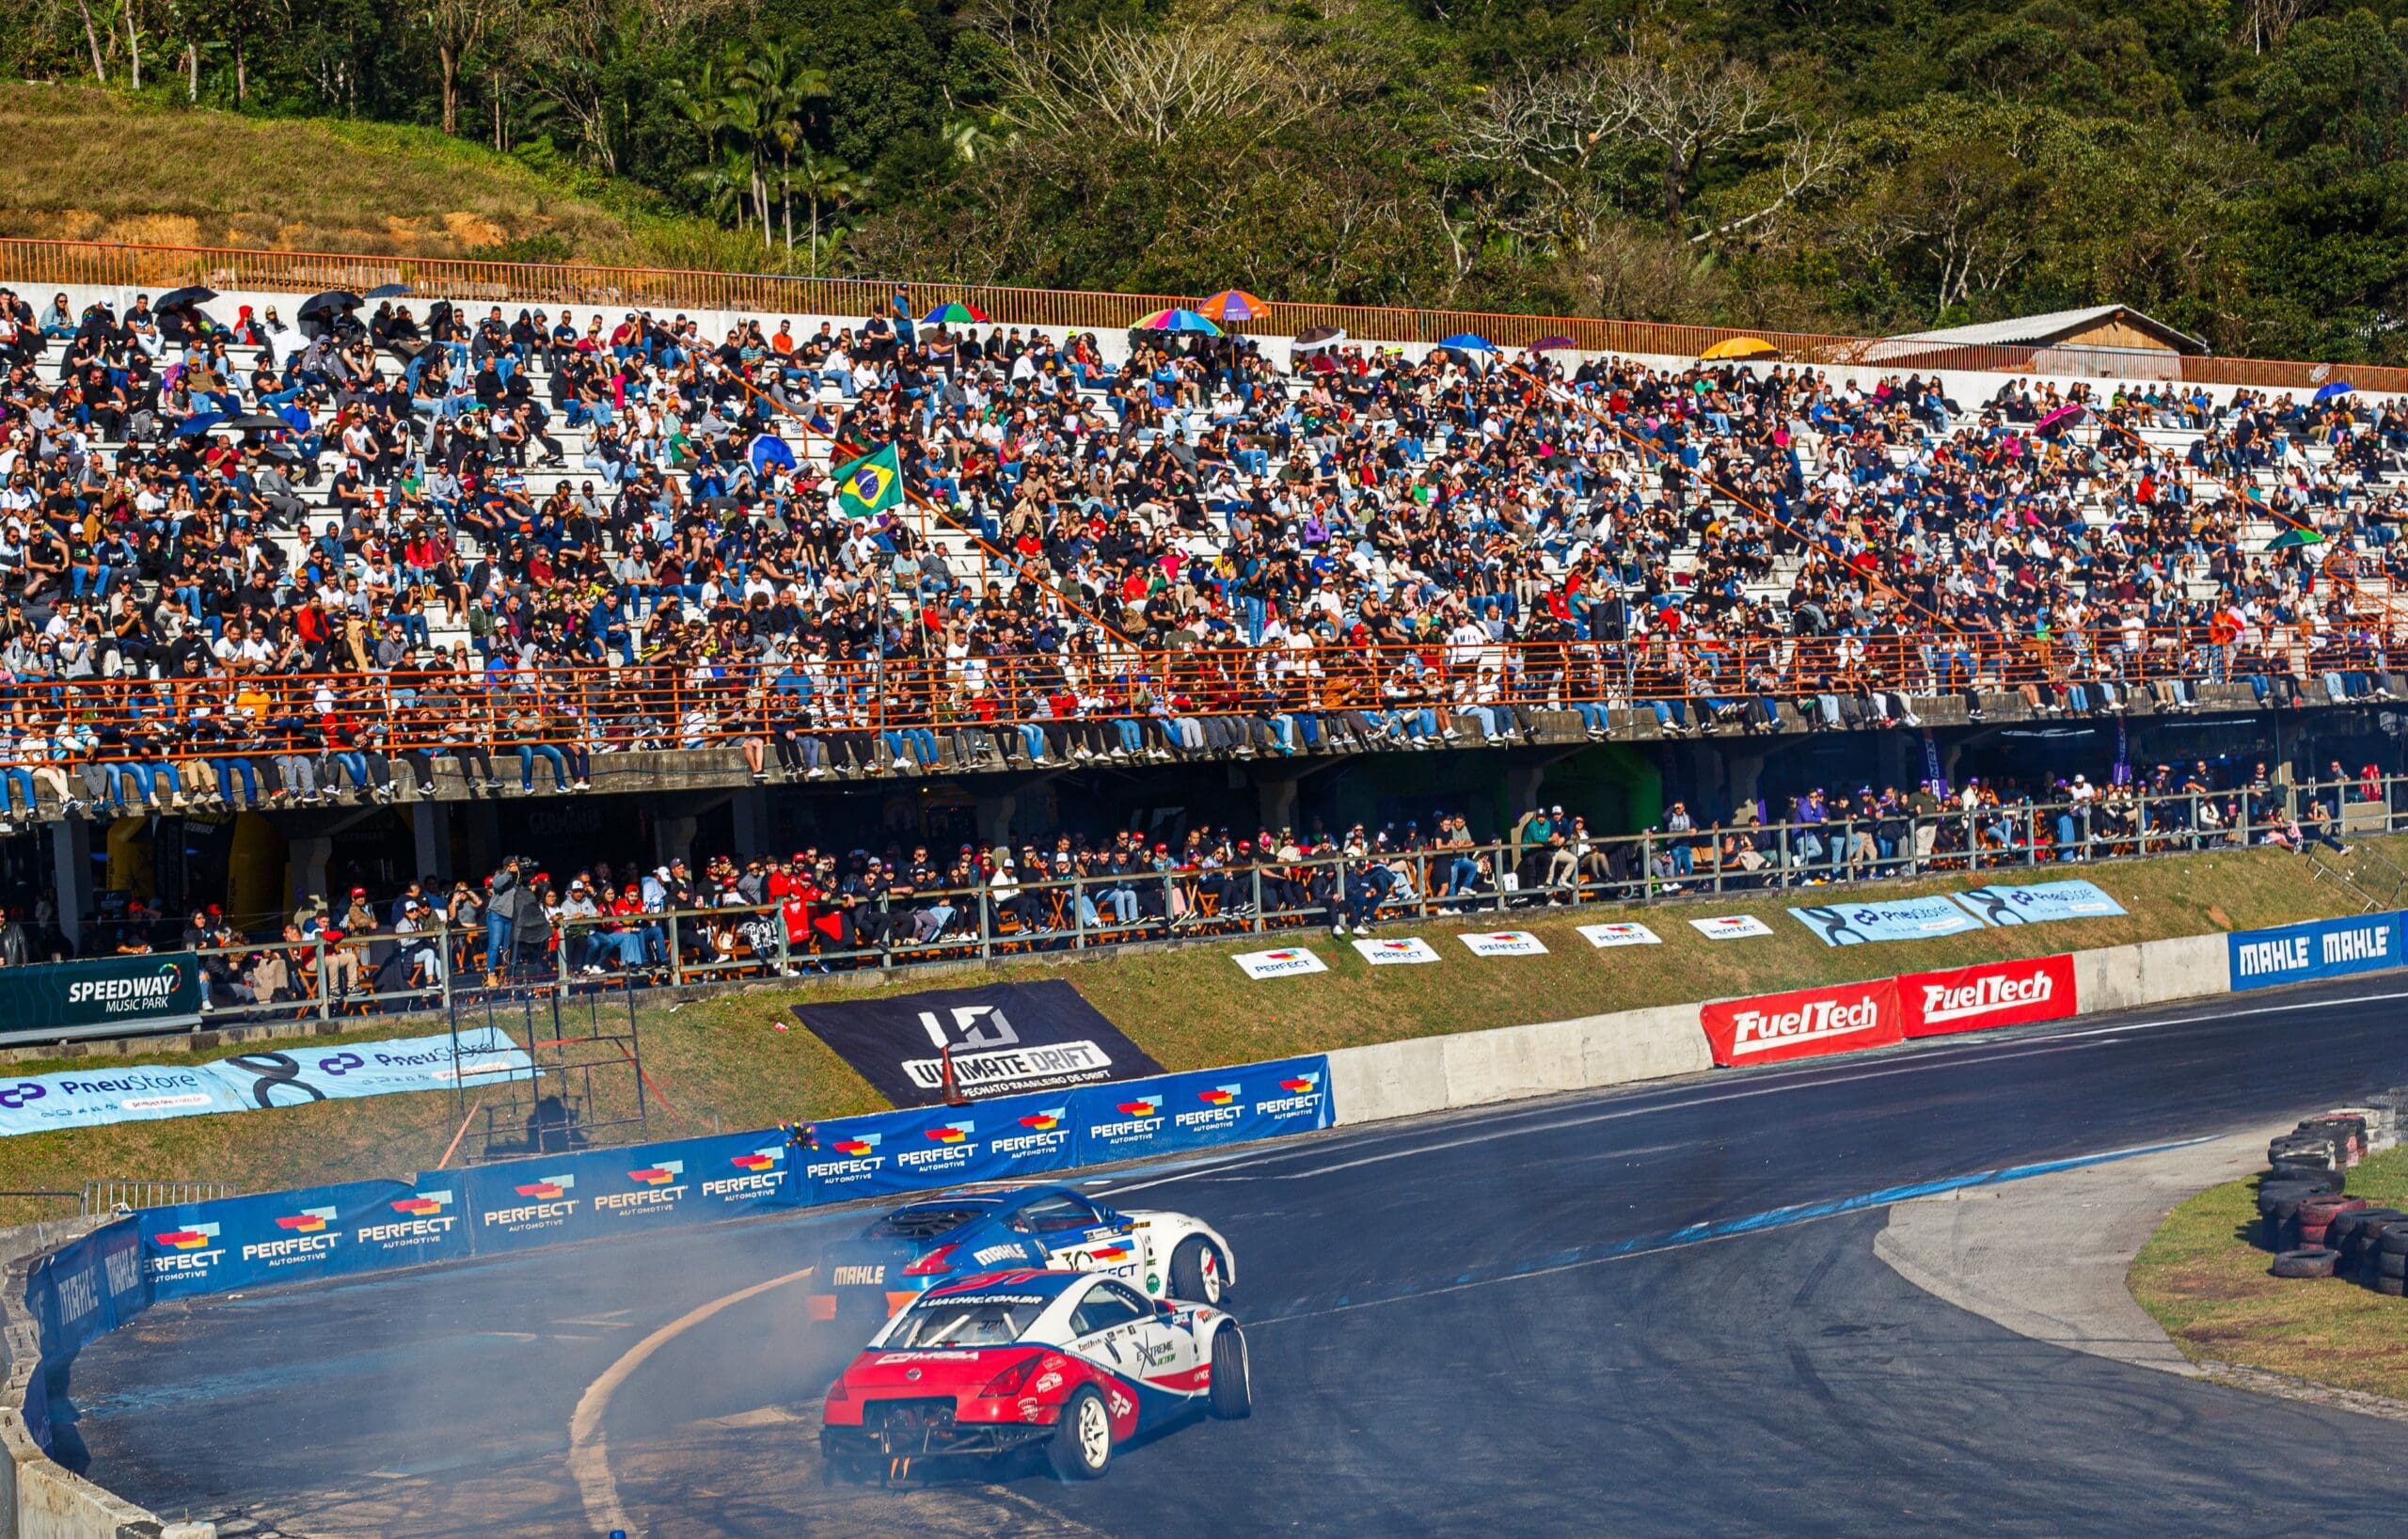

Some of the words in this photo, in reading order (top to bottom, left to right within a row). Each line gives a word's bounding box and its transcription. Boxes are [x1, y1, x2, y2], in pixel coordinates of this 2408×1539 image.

[1479, 943, 1531, 952] PERFECT
[1597, 932, 1645, 942] PERFECT
[1373, 950, 1423, 960] PERFECT
[2240, 937, 2309, 976] MAHLE
[2322, 926, 2387, 964] MAHLE
[1255, 960, 1309, 973] PERFECT
[69, 975, 175, 1003] SPEEDWAY
[1922, 970, 2052, 1014] FuelTech
[105, 997, 140, 1013] MUSIC
[141, 995, 168, 1010] PARK
[1733, 995, 1877, 1043] FuelTech
[914, 1054, 1032, 1084] ULIMATE
[1027, 1046, 1096, 1071] DRIFT
[59, 1072, 198, 1096] PneuStore
[961, 1083, 1009, 1099] PEONATO
[1010, 1075, 1069, 1091] BRASILEIRO
[1069, 1072, 1084, 1084] DE
[1083, 1070, 1112, 1082] DRIFT
[1256, 1092, 1323, 1116] PERFECT
[1275, 1108, 1313, 1120] AUTOMOTIVE
[1176, 1104, 1244, 1127] PERFECT
[1193, 1120, 1234, 1133] AUTOMOTIVE
[1090, 1117, 1165, 1139] PERFECT
[1109, 1133, 1153, 1145] AUTOMOTIVE
[991, 1129, 1069, 1154] PERFECT
[897, 1143, 978, 1167] PERFECT
[1011, 1147, 1057, 1160] AUTOMOTIVE
[807, 1156, 885, 1180] PERFECT
[918, 1160, 966, 1173] AUTOMOTIVE
[702, 1170, 787, 1197] PERFECT
[824, 1173, 872, 1185] AUTOMOTIVE
[594, 1185, 688, 1211] PERFECT
[723, 1188, 776, 1202] AUTOMOTIVE
[483, 1199, 578, 1227] PERFECT
[618, 1204, 674, 1217] AUTOMOTIVE
[357, 1216, 456, 1244] PERFECT
[508, 1219, 564, 1232] AUTOMOTIVE
[242, 1232, 341, 1261] PERFECT
[382, 1235, 441, 1249] AUTOMOTIVE
[144, 1249, 224, 1275] ERFECT
[268, 1252, 326, 1268] AUTOMOTIVE
[974, 1244, 1028, 1266] MAHLE
[833, 1265, 886, 1287] MAHLE
